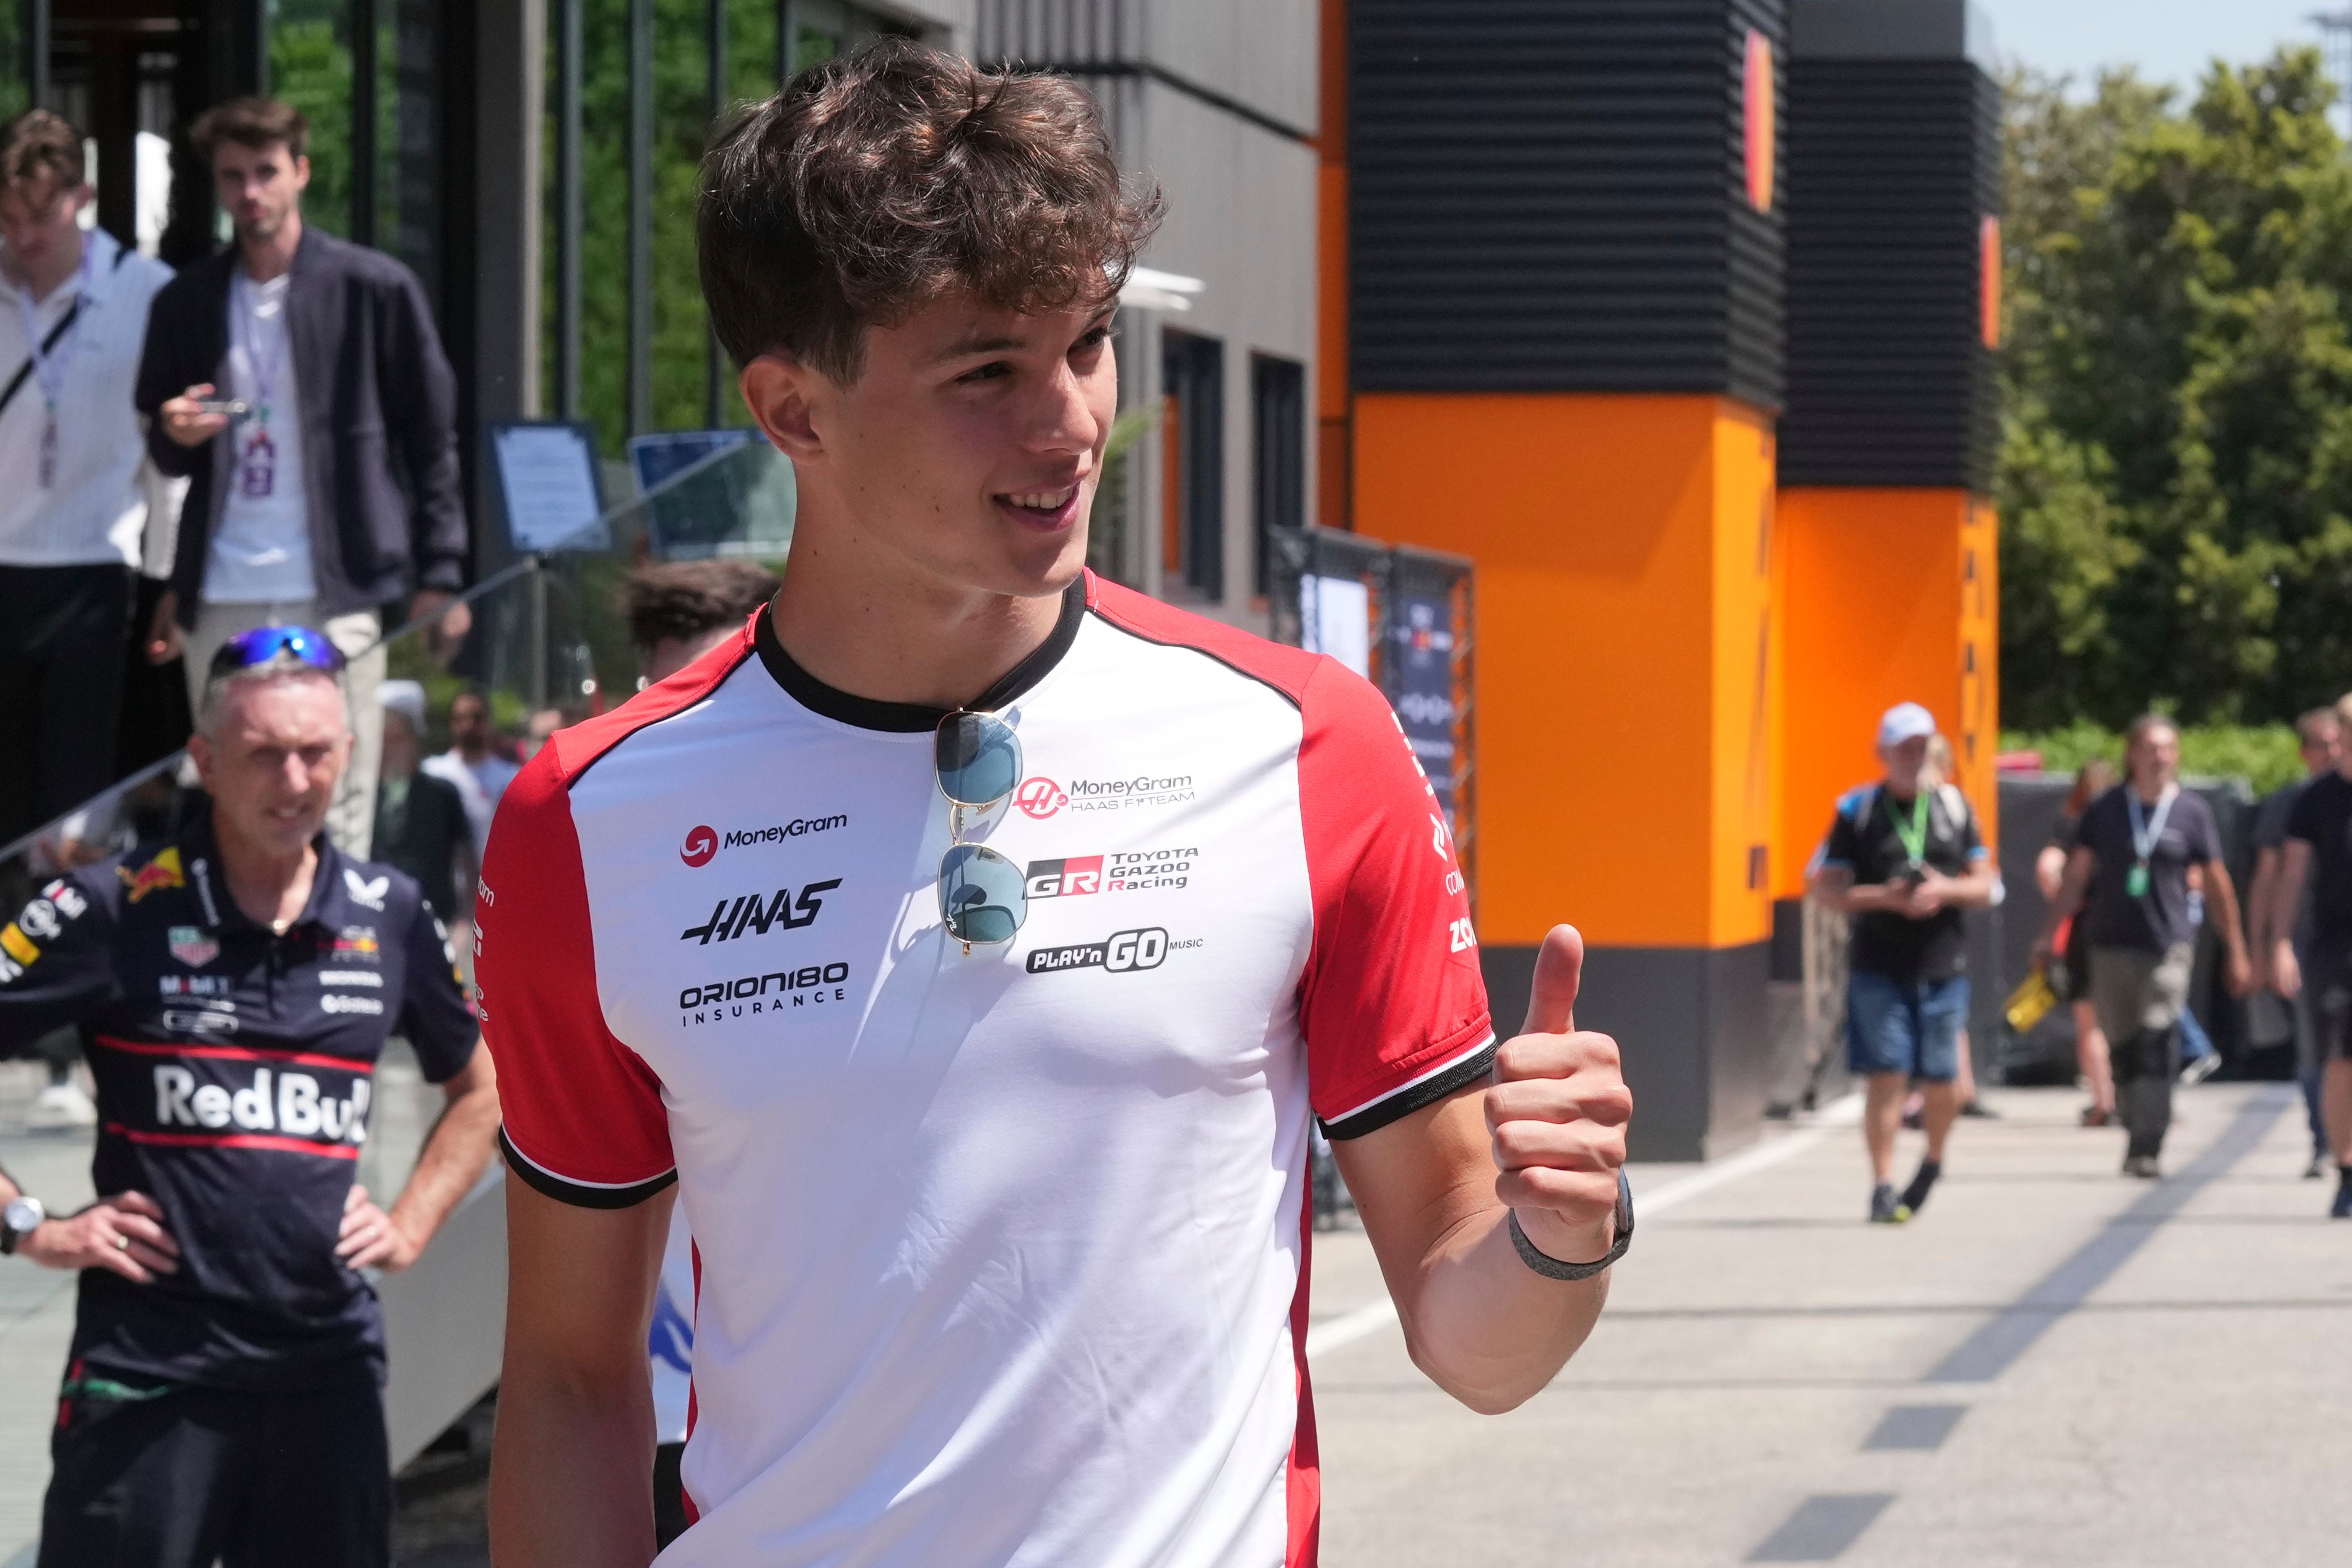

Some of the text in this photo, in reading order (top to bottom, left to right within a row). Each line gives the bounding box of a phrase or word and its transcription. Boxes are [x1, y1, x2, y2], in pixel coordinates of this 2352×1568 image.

[1071, 776, 1192, 796] MoneyGram
[1071, 800, 1119, 812] HAAS
[1145, 791, 1195, 805] TEAM
[724, 814, 848, 849] MoneyGram
[1109, 862, 1190, 878] GAZOO
[1111, 847, 1199, 865] TOYOTA
[1026, 870, 1099, 894] GR
[1108, 876, 1187, 892] Racing
[680, 878, 843, 945] HAAS
[1106, 929, 1167, 969] GO
[1169, 938, 1204, 951] MUSIC
[680, 961, 849, 1010] ORION180
[683, 989, 844, 1028] INSURANCE
[154, 1064, 275, 1130] Red
